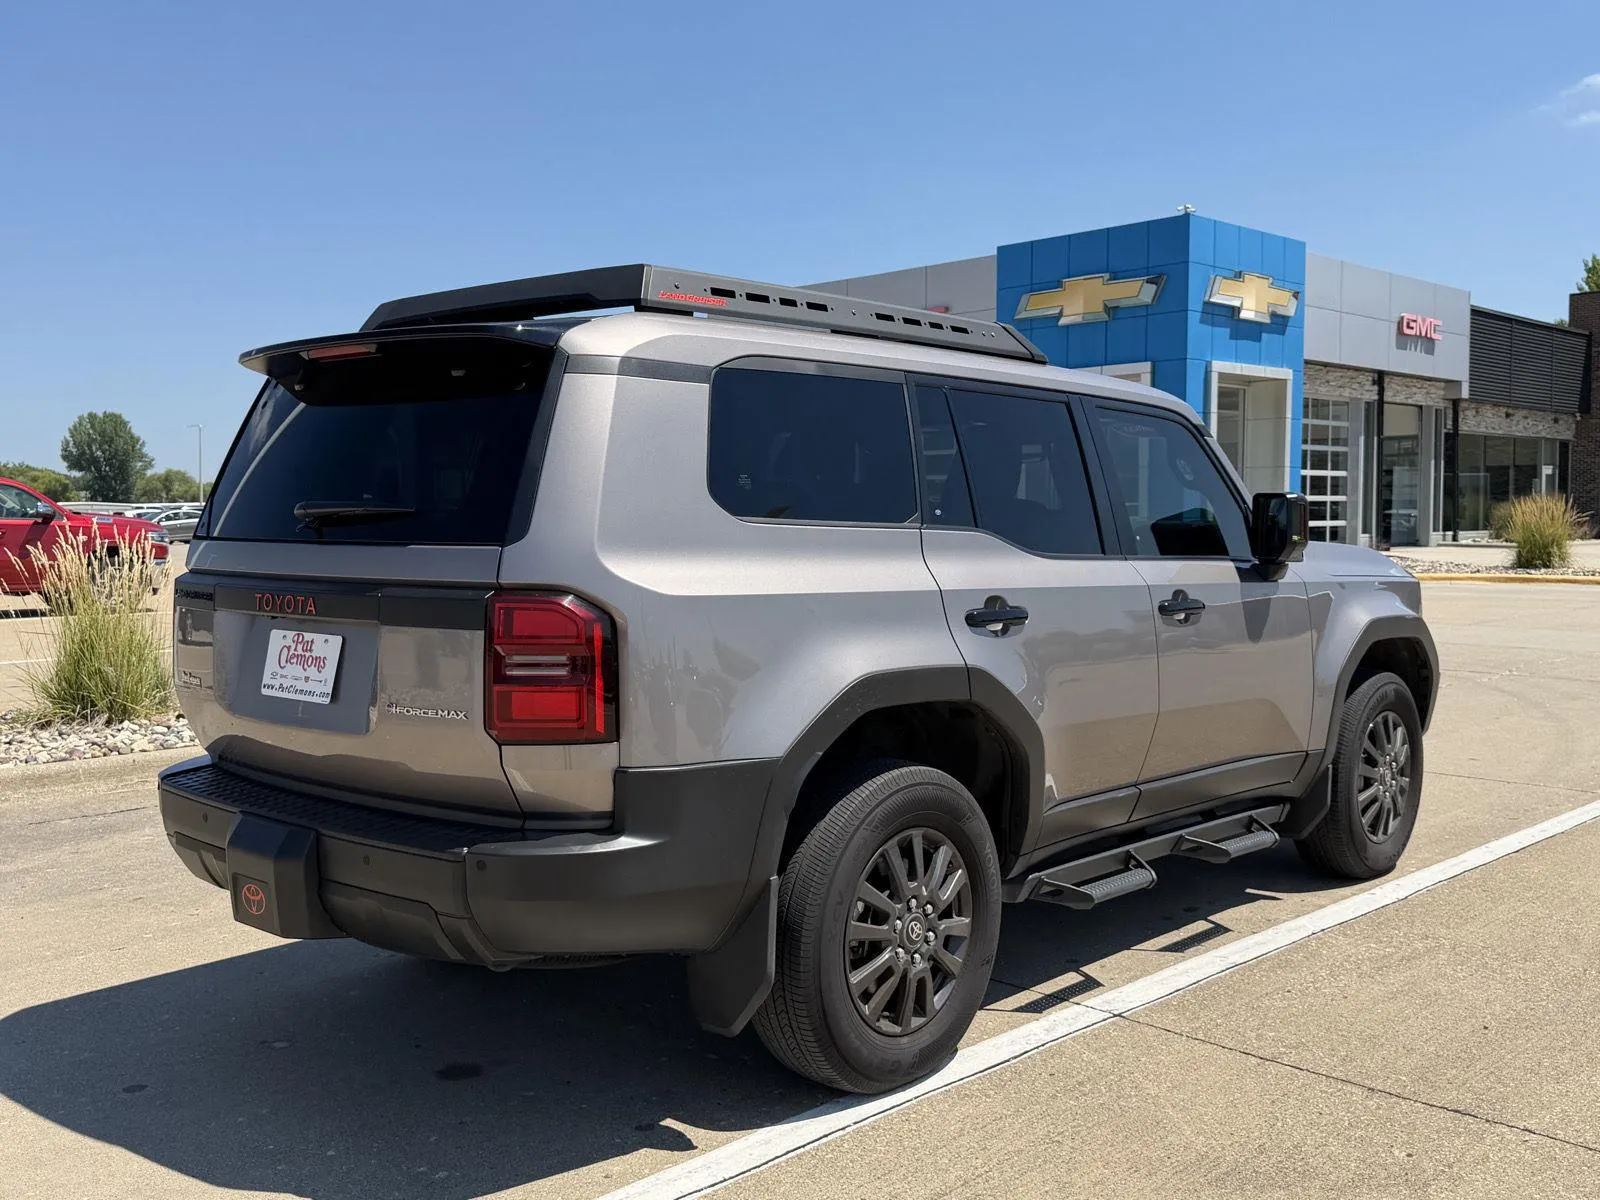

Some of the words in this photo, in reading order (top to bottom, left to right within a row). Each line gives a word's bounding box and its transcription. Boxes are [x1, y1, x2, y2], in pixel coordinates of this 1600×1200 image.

[1398, 313, 1443, 340] GMC
[255, 593, 316, 614] TOYOTA
[292, 632, 315, 653] Pat
[278, 645, 328, 674] Clemons
[262, 683, 331, 699] www.PatClemons.com
